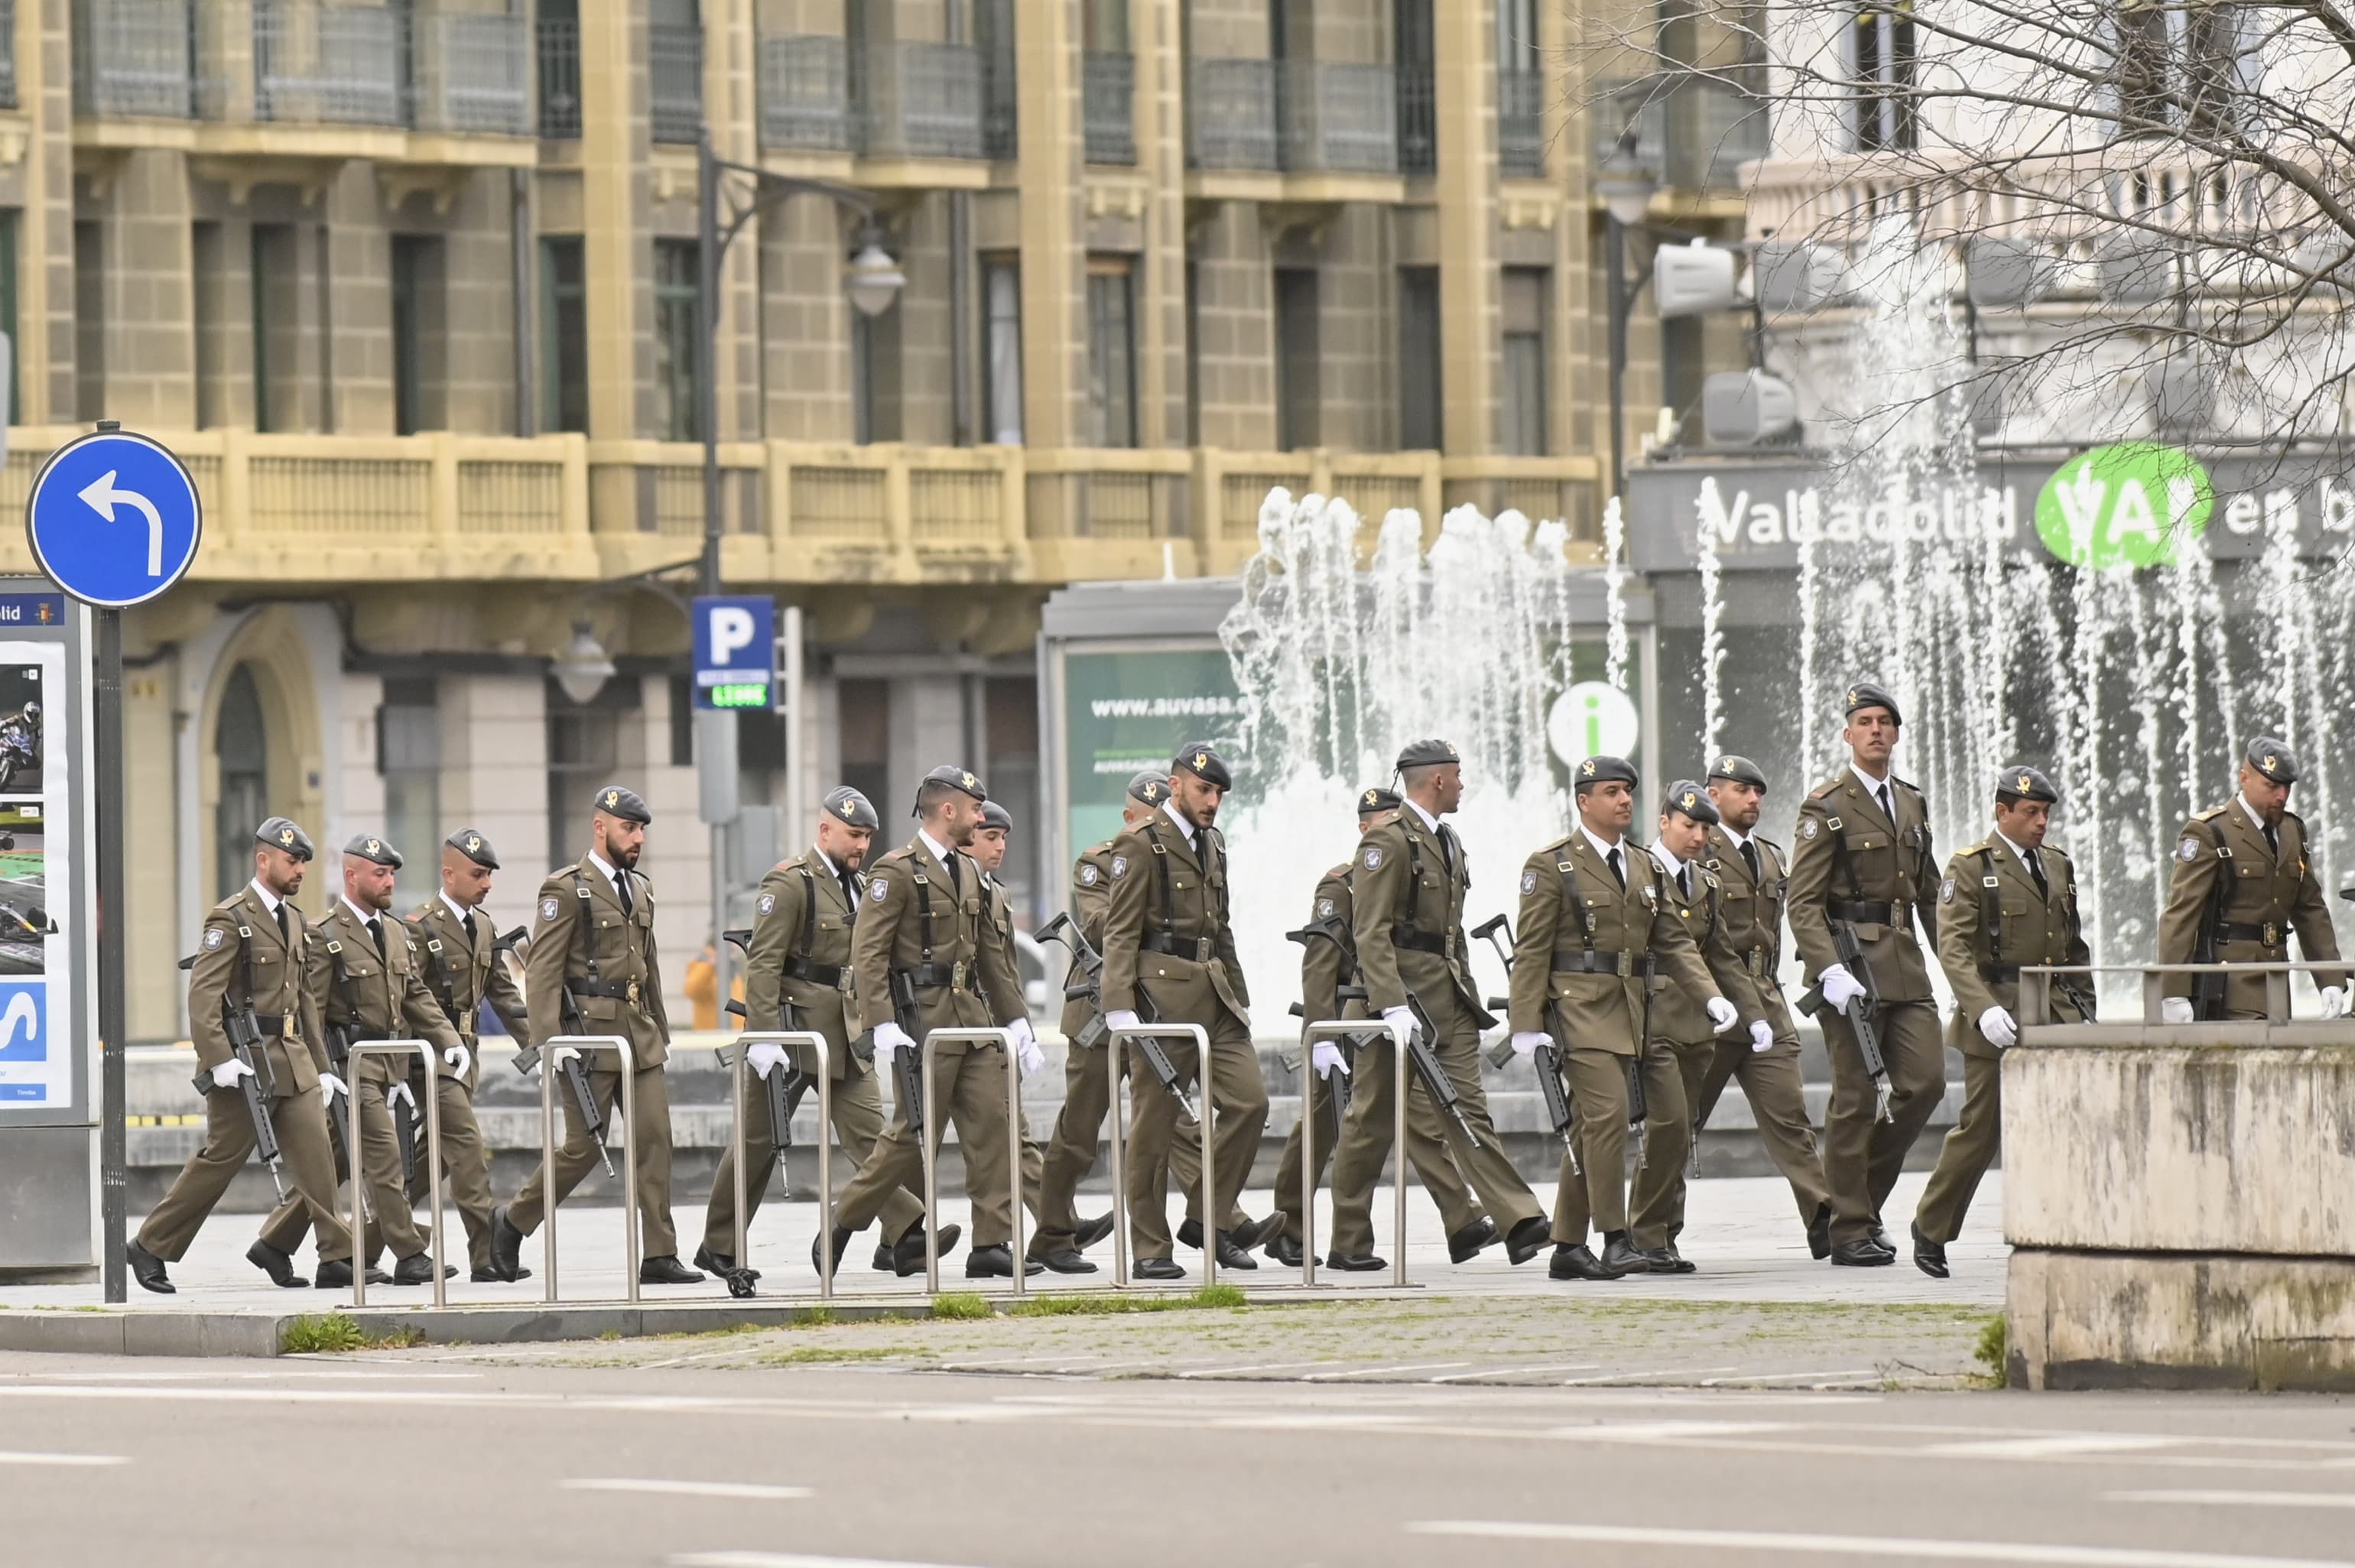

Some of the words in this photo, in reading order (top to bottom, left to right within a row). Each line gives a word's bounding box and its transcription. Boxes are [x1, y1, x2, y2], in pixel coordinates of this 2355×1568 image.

[2225, 489, 2299, 534] en
[0, 605, 21, 621] lid
[710, 606, 755, 665] P
